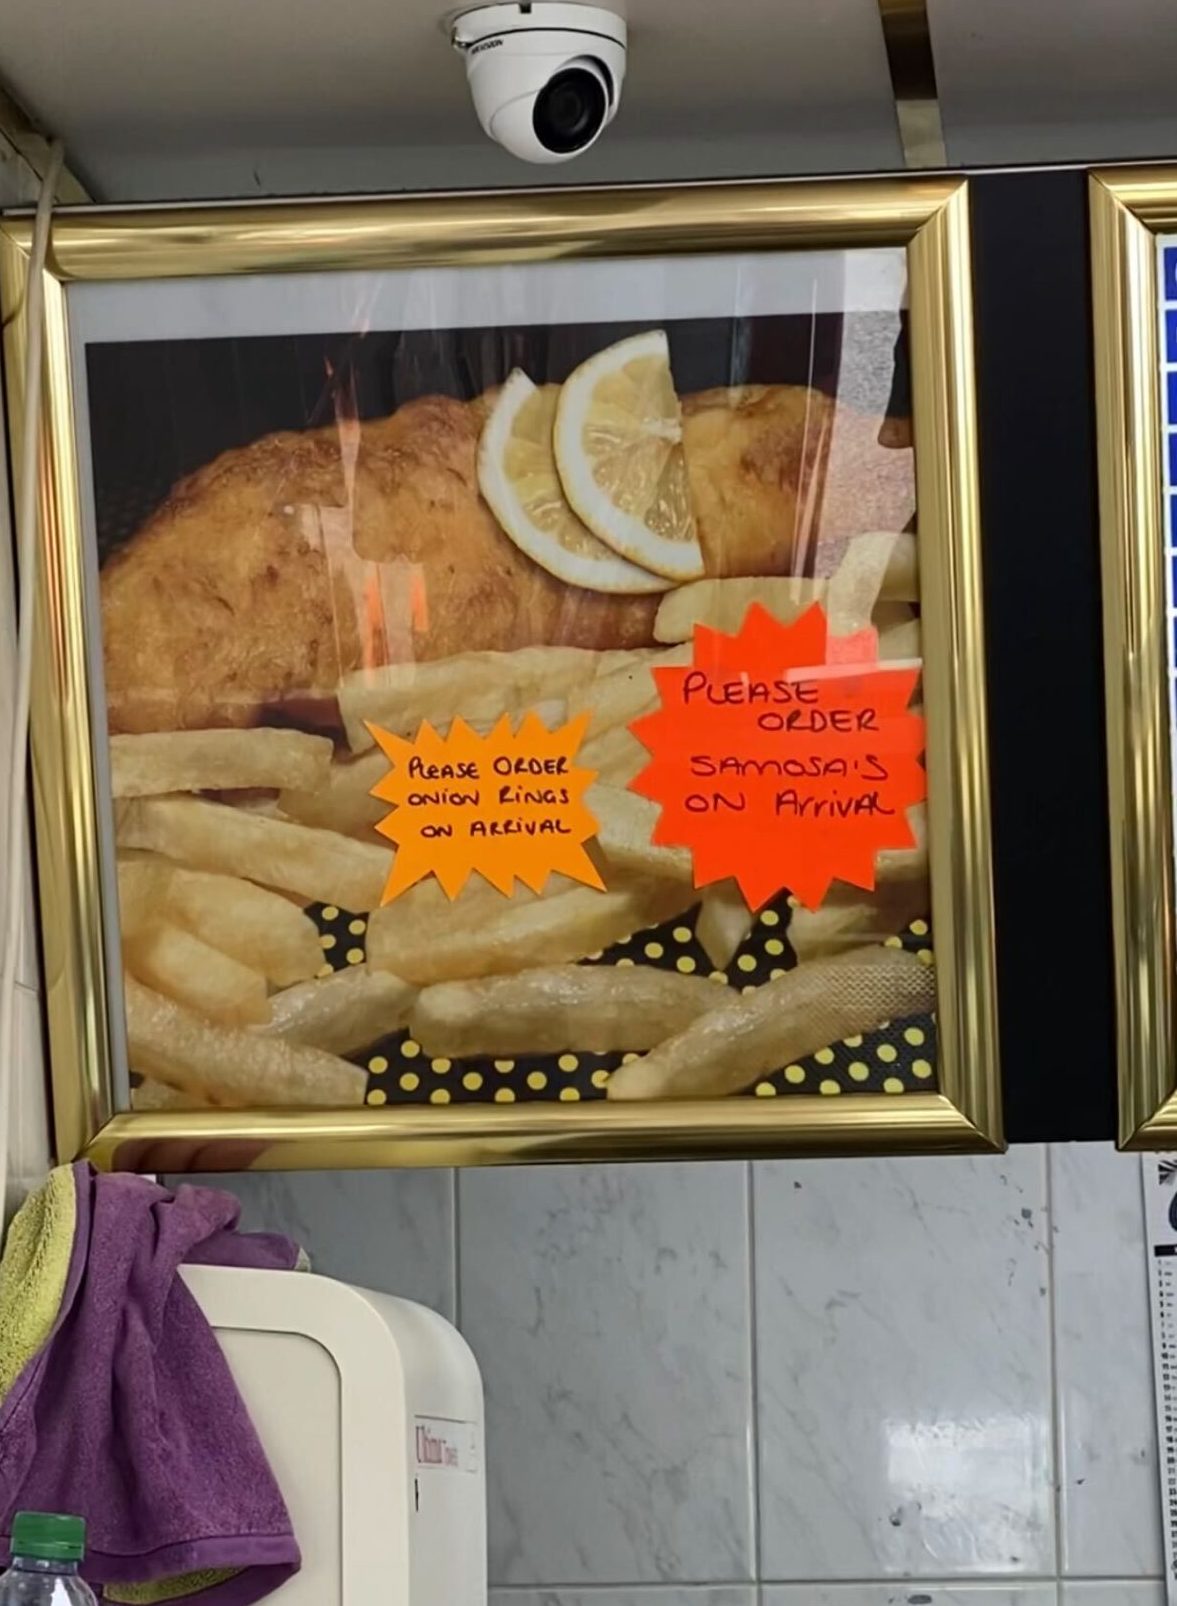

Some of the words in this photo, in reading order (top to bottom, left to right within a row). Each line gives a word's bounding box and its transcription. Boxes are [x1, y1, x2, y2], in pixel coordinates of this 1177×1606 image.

[683, 671, 819, 704] PLEASE
[757, 708, 879, 732] ORDER
[493, 756, 569, 776] ORDER
[684, 792, 746, 813] ON
[420, 824, 453, 838] ON
